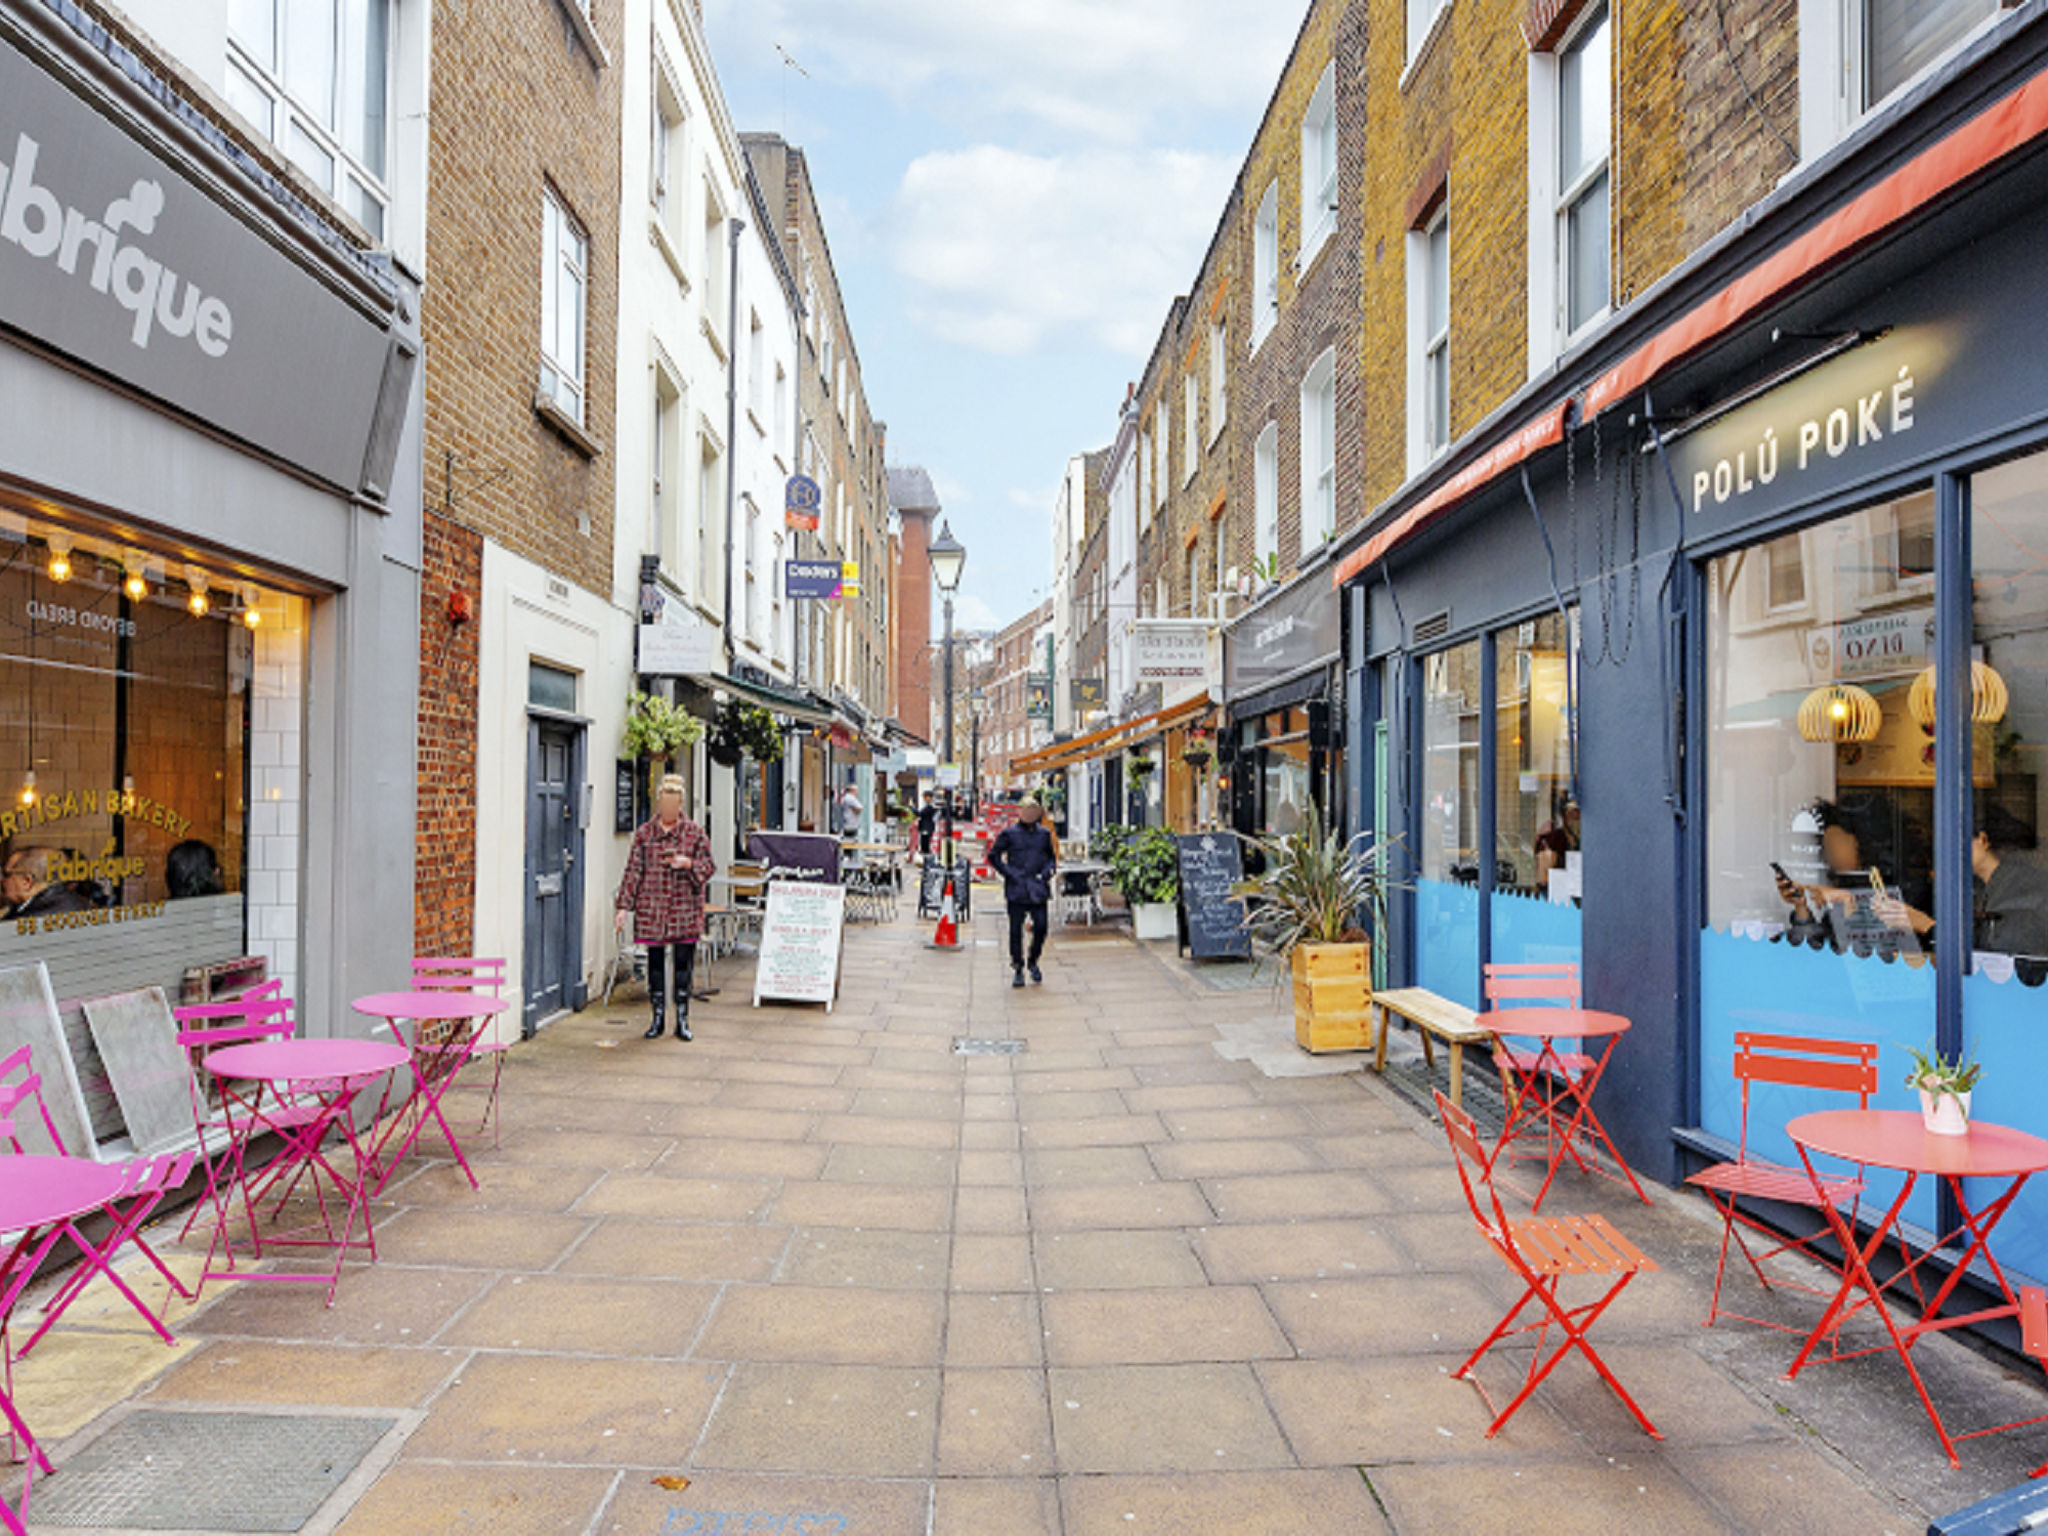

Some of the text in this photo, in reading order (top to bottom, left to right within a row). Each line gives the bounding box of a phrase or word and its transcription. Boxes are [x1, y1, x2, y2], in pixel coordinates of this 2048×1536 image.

[0, 132, 233, 358] brique
[1798, 365, 1914, 471] POKÉ
[0, 789, 192, 843] RTISAN BAKERY
[46, 838, 146, 887] Fabrique
[113, 900, 166, 923] STREET
